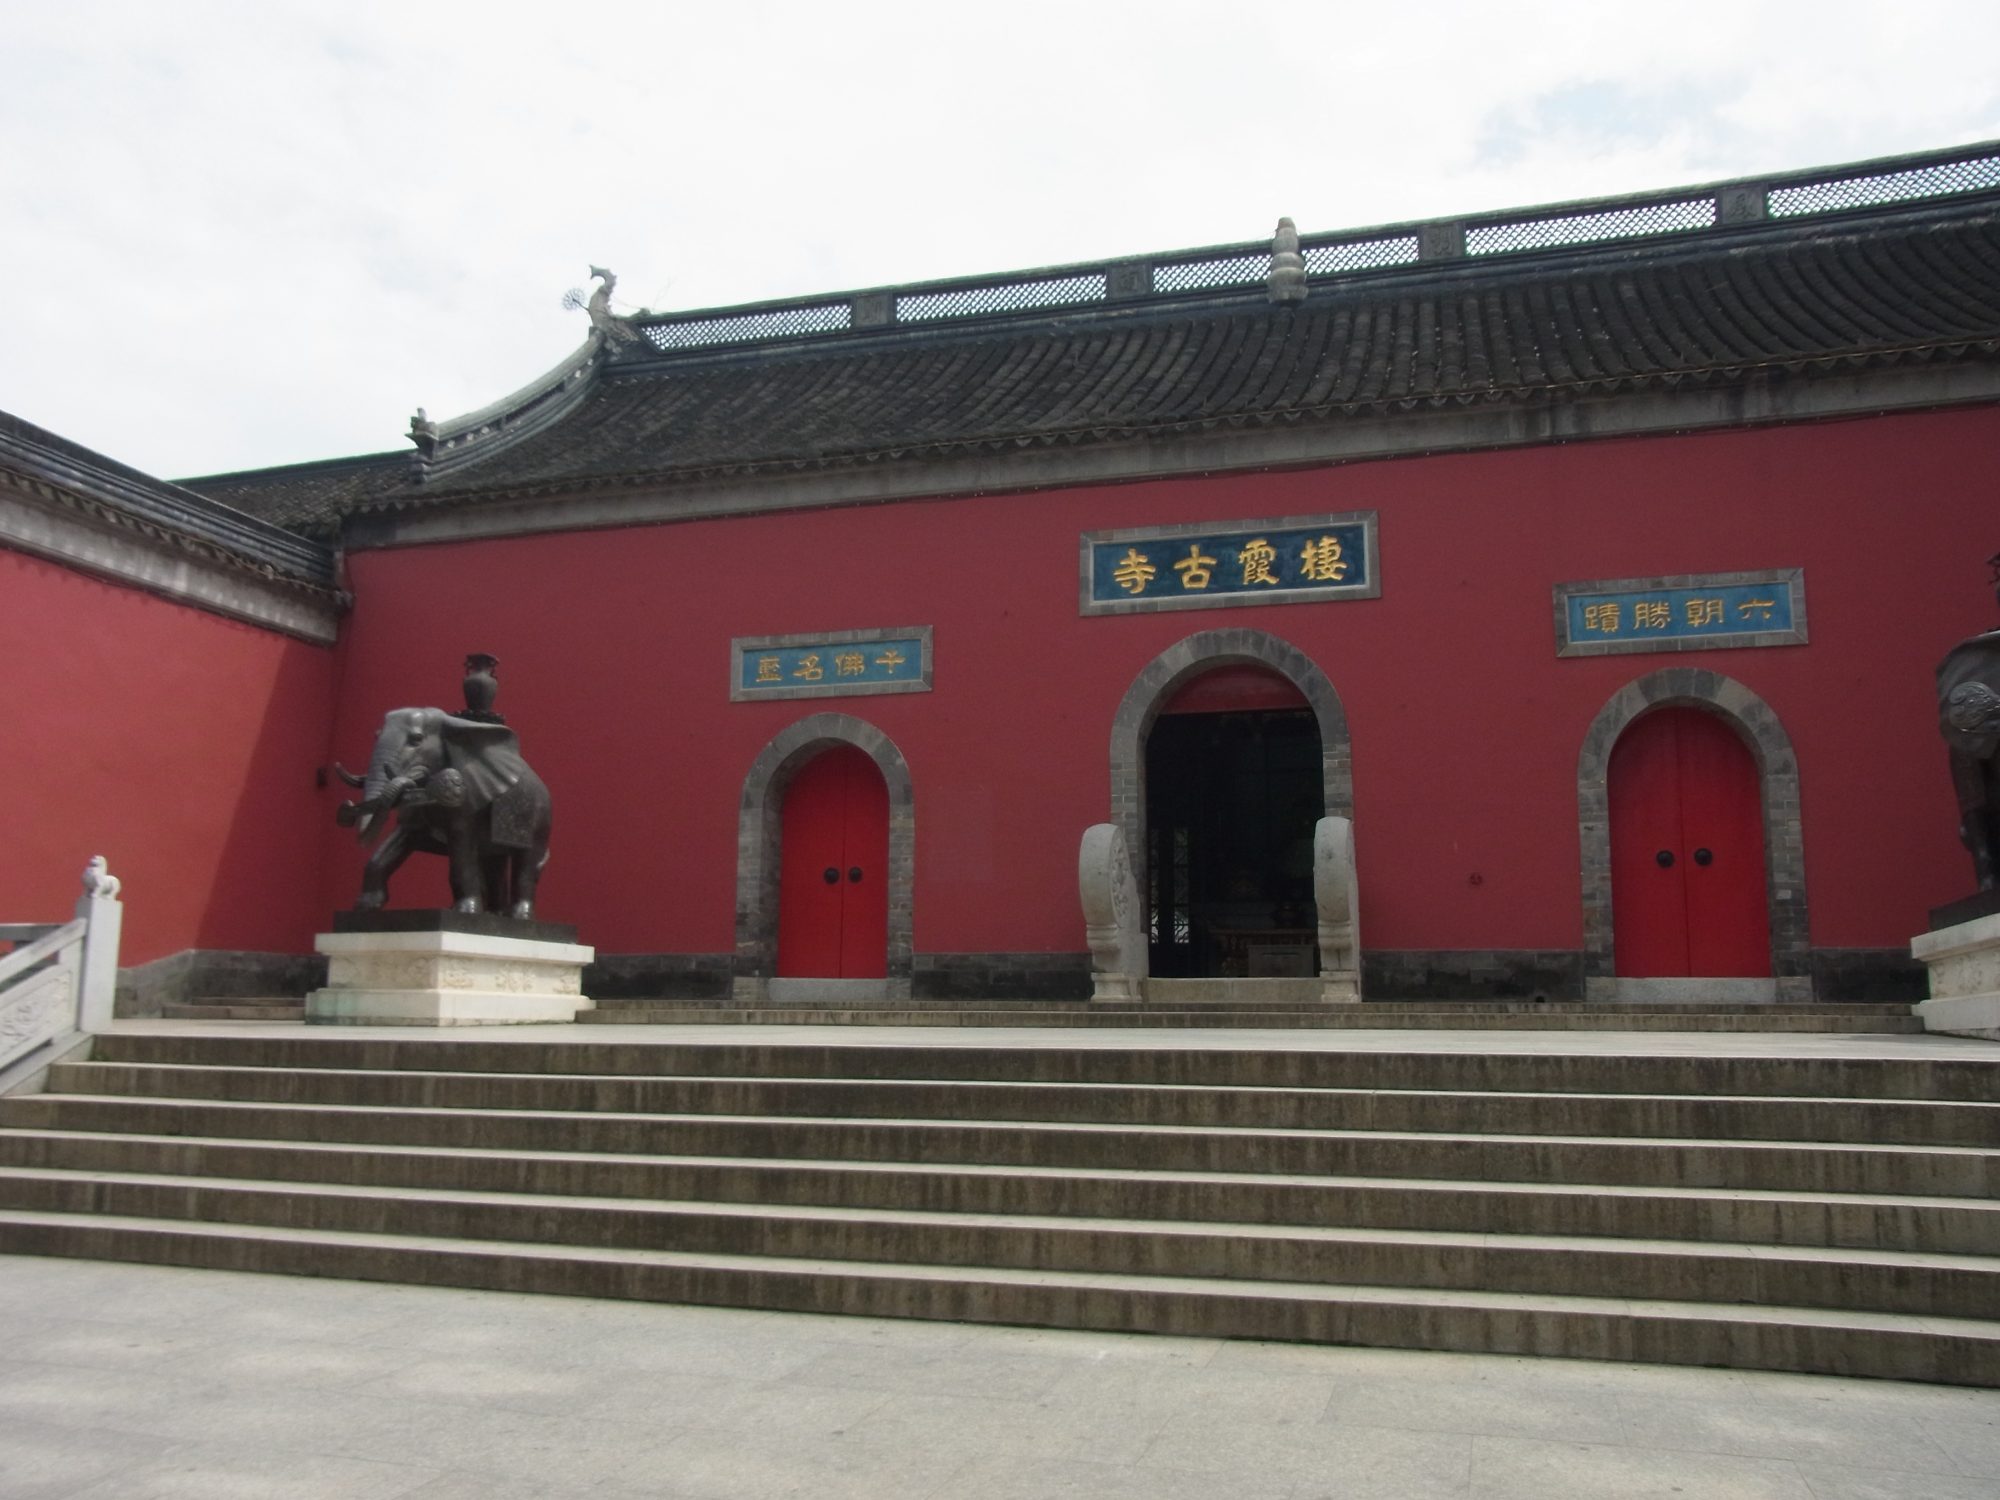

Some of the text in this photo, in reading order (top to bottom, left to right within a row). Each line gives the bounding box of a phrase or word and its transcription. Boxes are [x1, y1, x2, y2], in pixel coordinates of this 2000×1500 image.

[1113, 534, 1348, 594] 棲霞古寺
[1584, 598, 1776, 633] 六朝勝蹟
